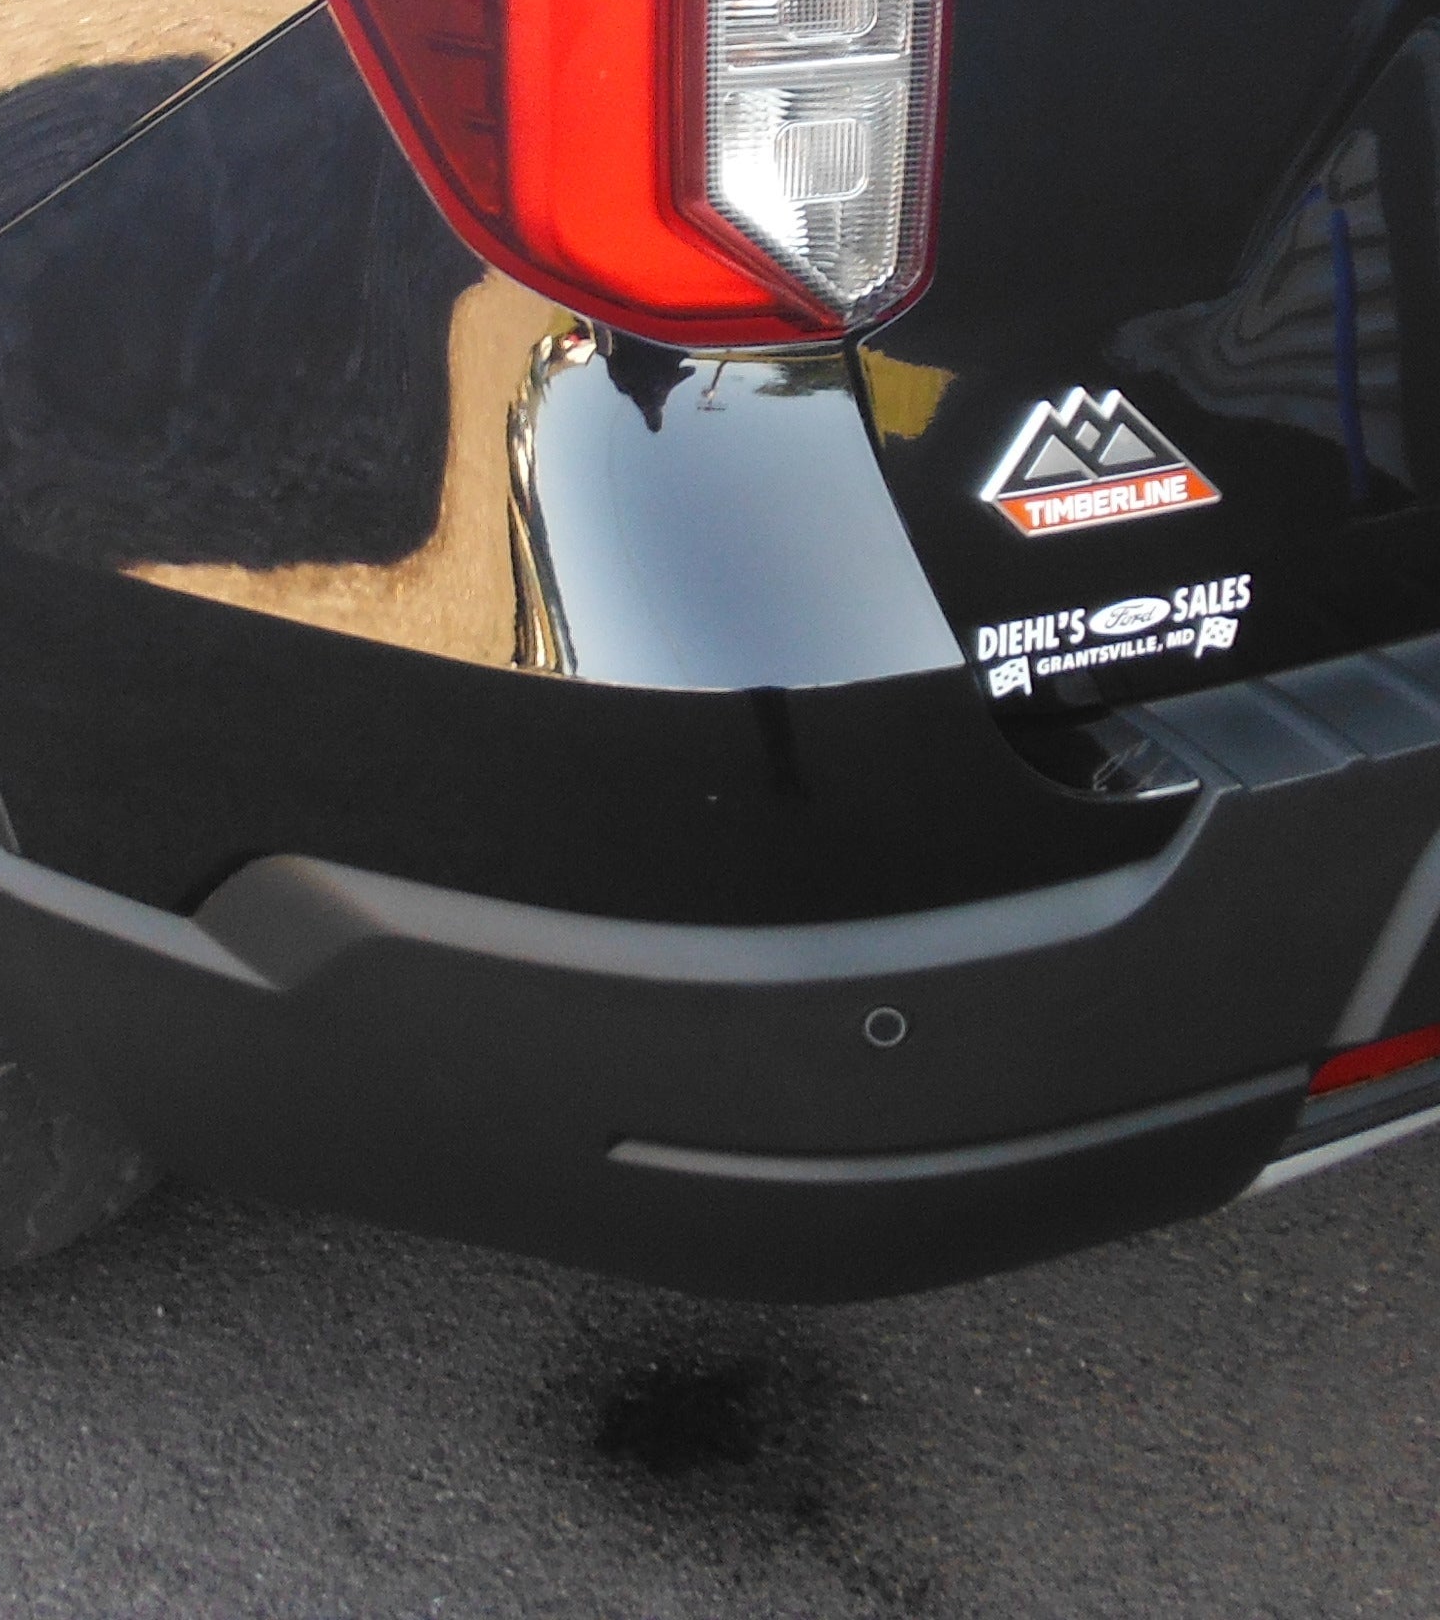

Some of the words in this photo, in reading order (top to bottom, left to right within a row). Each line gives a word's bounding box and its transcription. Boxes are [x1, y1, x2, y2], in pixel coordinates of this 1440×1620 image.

[1025, 475, 1188, 527] TIMBERLINE
[978, 608, 1086, 661] DIEHL'S
[1104, 603, 1157, 630] Ford
[1173, 574, 1252, 623] SALES
[1036, 636, 1163, 676] GRANTSVILLE,
[1167, 628, 1194, 648] MD
